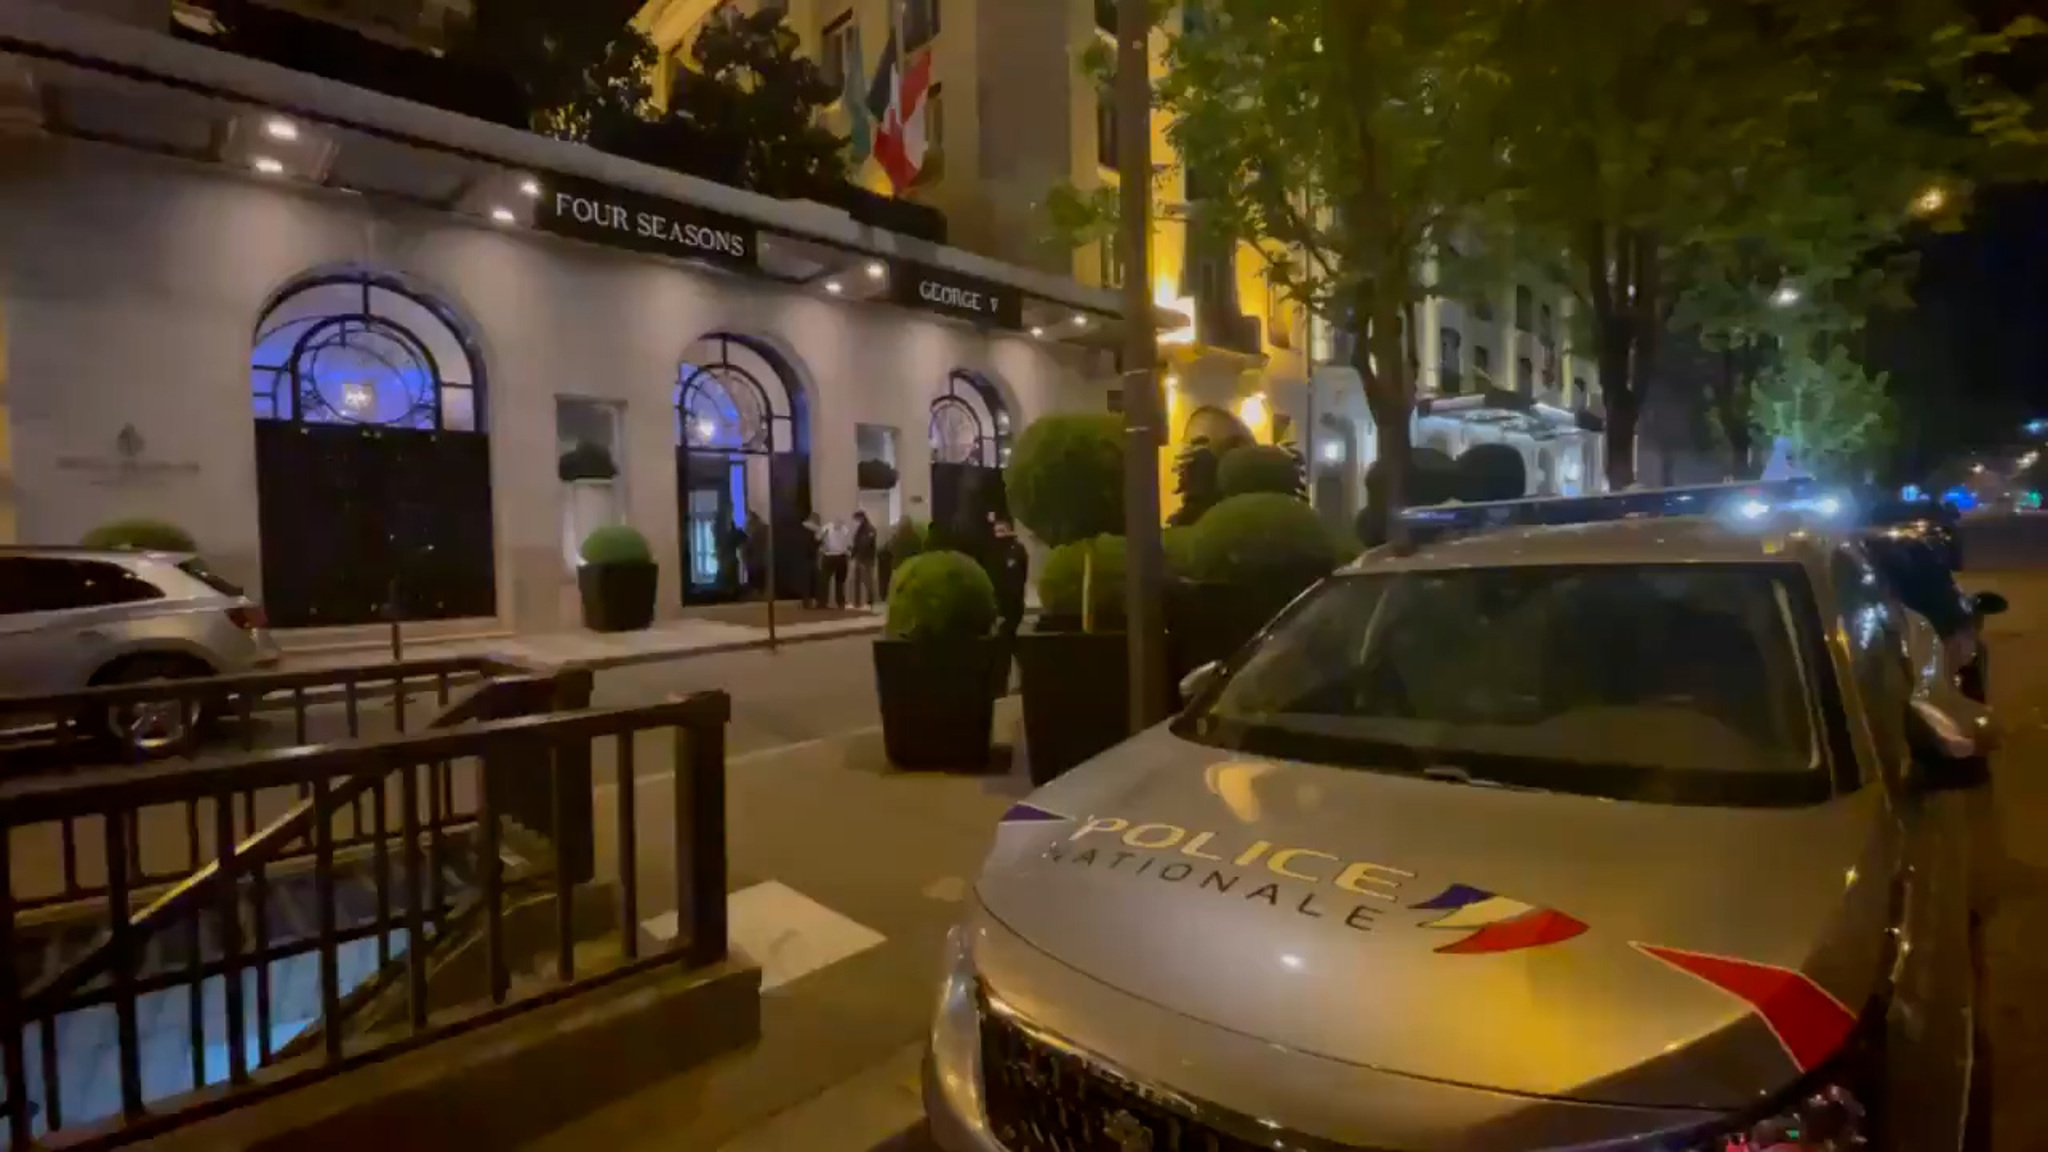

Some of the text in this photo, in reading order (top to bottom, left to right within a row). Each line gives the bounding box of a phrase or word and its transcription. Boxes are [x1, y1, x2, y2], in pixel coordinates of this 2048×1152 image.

[555, 192, 745, 257] FOUR SEASONS
[919, 280, 999, 313] GEORGE V
[1068, 815, 1419, 902] POLICE
